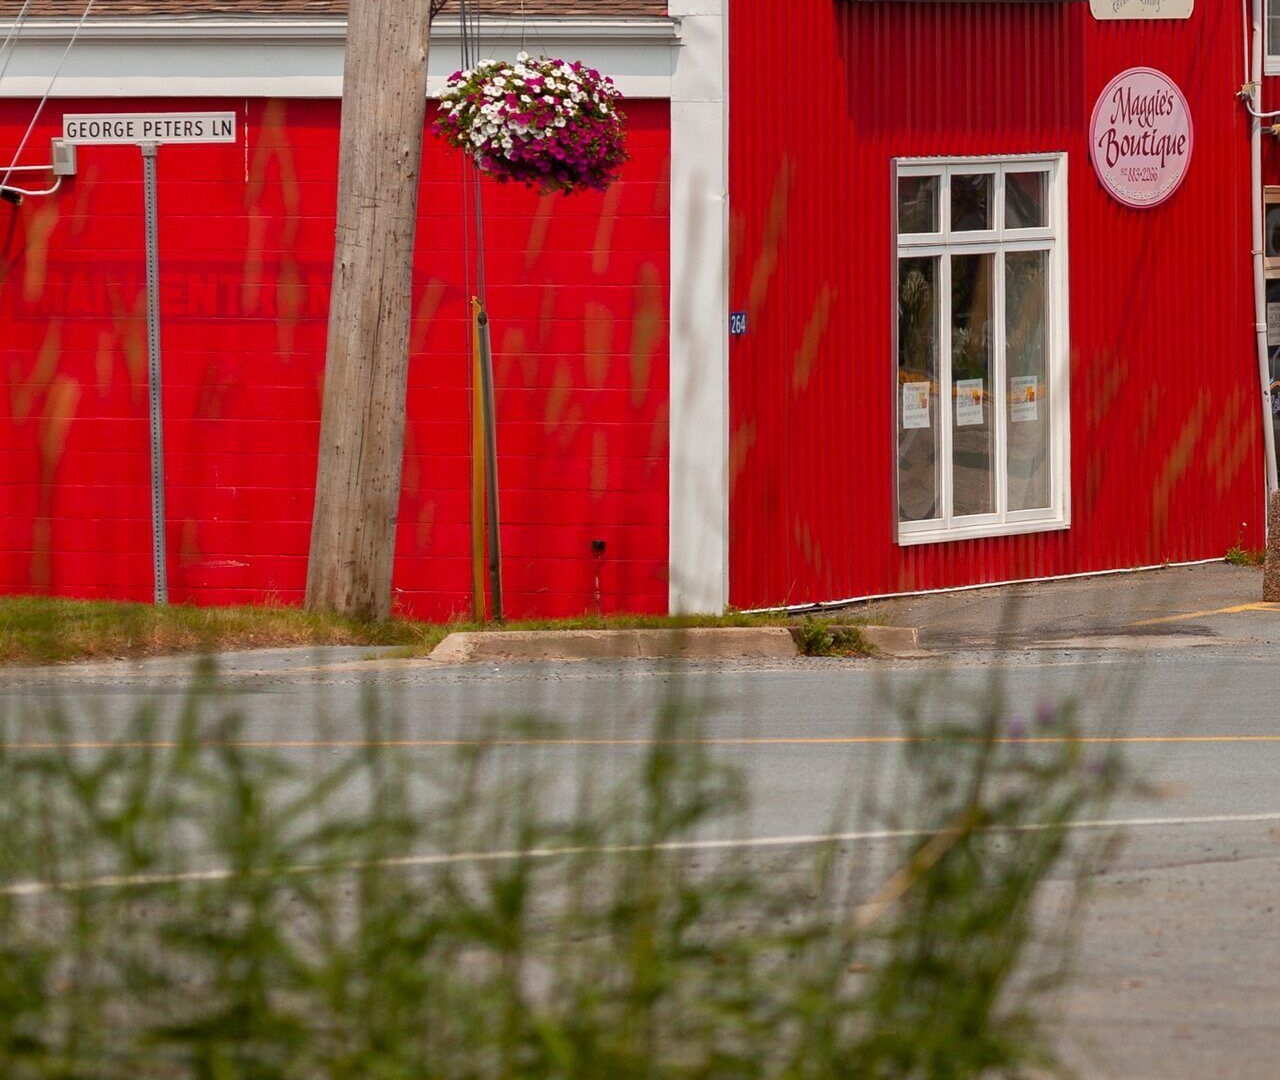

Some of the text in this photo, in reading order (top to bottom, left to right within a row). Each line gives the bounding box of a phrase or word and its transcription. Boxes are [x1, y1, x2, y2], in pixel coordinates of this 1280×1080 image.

[1111, 86, 1174, 128] Maggie's
[67, 120, 232, 138] GEORGE PETERS LN
[1098, 128, 1186, 168] Boutique
[731, 314, 746, 333] 264
